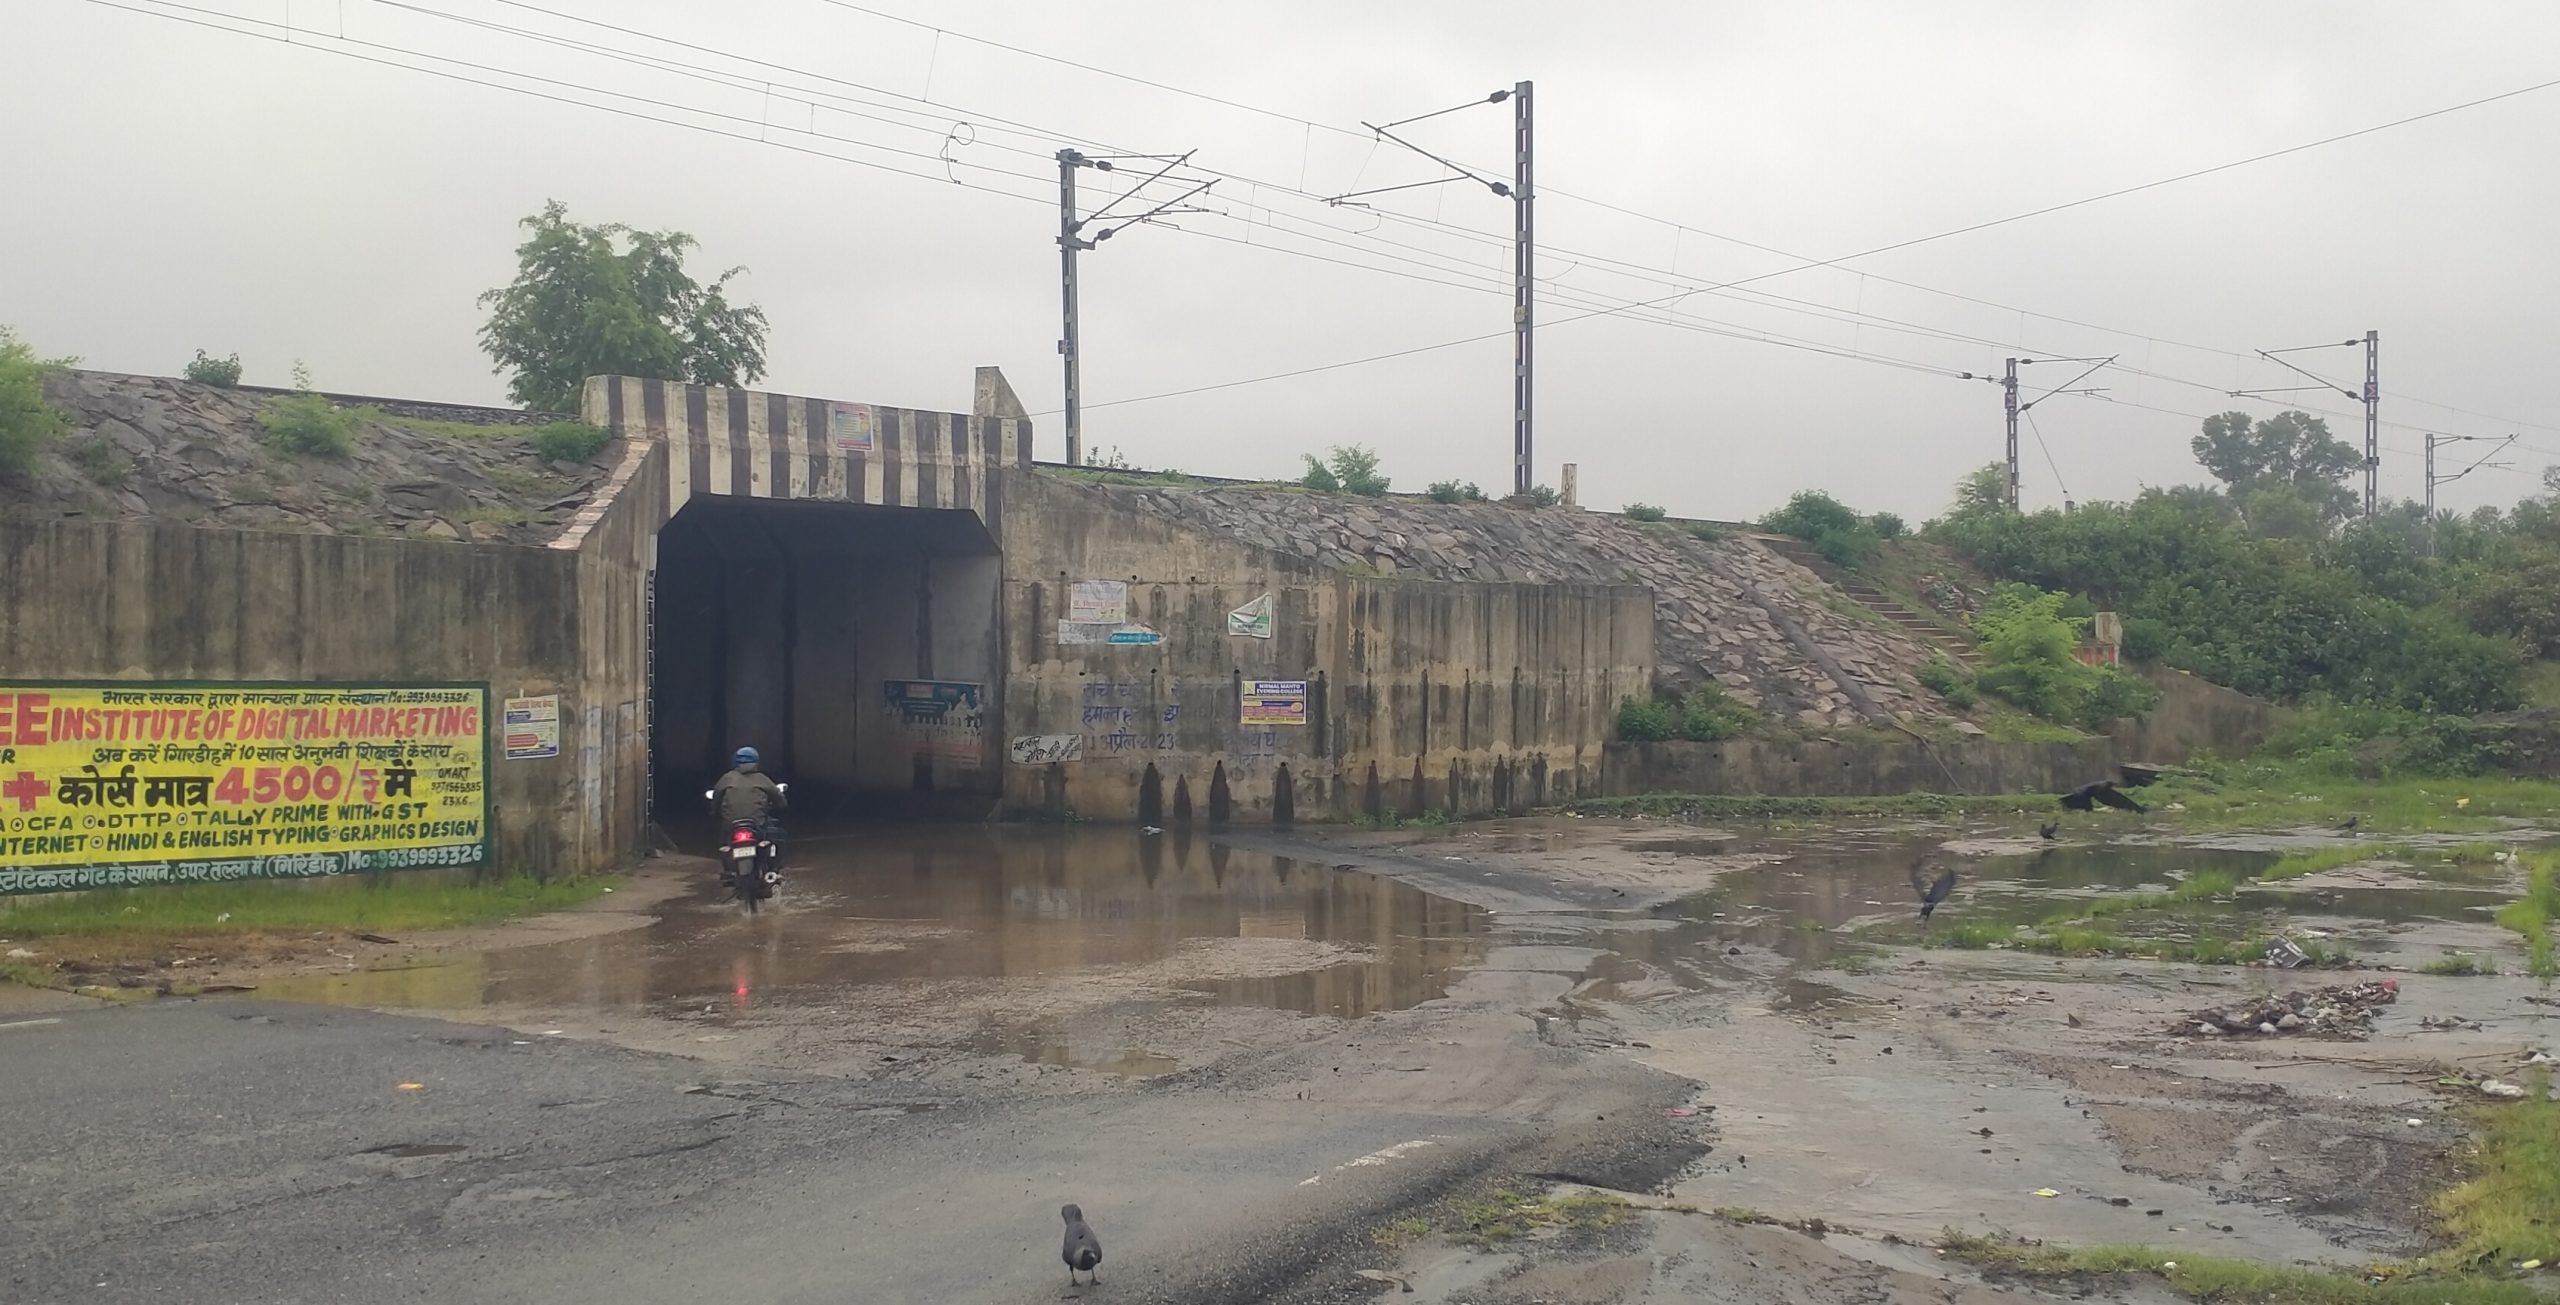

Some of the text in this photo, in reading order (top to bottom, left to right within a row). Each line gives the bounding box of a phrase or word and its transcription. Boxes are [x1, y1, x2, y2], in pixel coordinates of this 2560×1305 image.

[103, 691, 145, 706] भारत
[150, 692, 204, 708] सरकार
[208, 693, 240, 709] द्वारा
[243, 693, 298, 705] मान्यता
[51, 707, 202, 743] INSTITUTE
[203, 708, 236, 741] OF
[237, 708, 331, 740] DIGITAL
[334, 705, 478, 739] MARKETING
[93, 748, 127, 763] अब
[129, 743, 161, 764] करें
[239, 745, 256, 761] 10
[257, 746, 291, 762] साल
[294, 742, 352, 765] अनुभवी
[58, 765, 139, 808] कोर्स
[144, 775, 214, 808] मात्र
[384, 758, 417, 798] में
[28, 815, 73, 832] CFA
[108, 811, 172, 829] DTTP
[191, 807, 267, 827] TALLY
[272, 804, 329, 824] PRIME
[107, 832, 159, 851] HINDI
[162, 831, 175, 849] &
[179, 828, 254, 849] ENGLISH
[257, 825, 331, 846] TYPING
[340, 823, 416, 842] GRAPHICS
[419, 820, 479, 839] DESIGN
